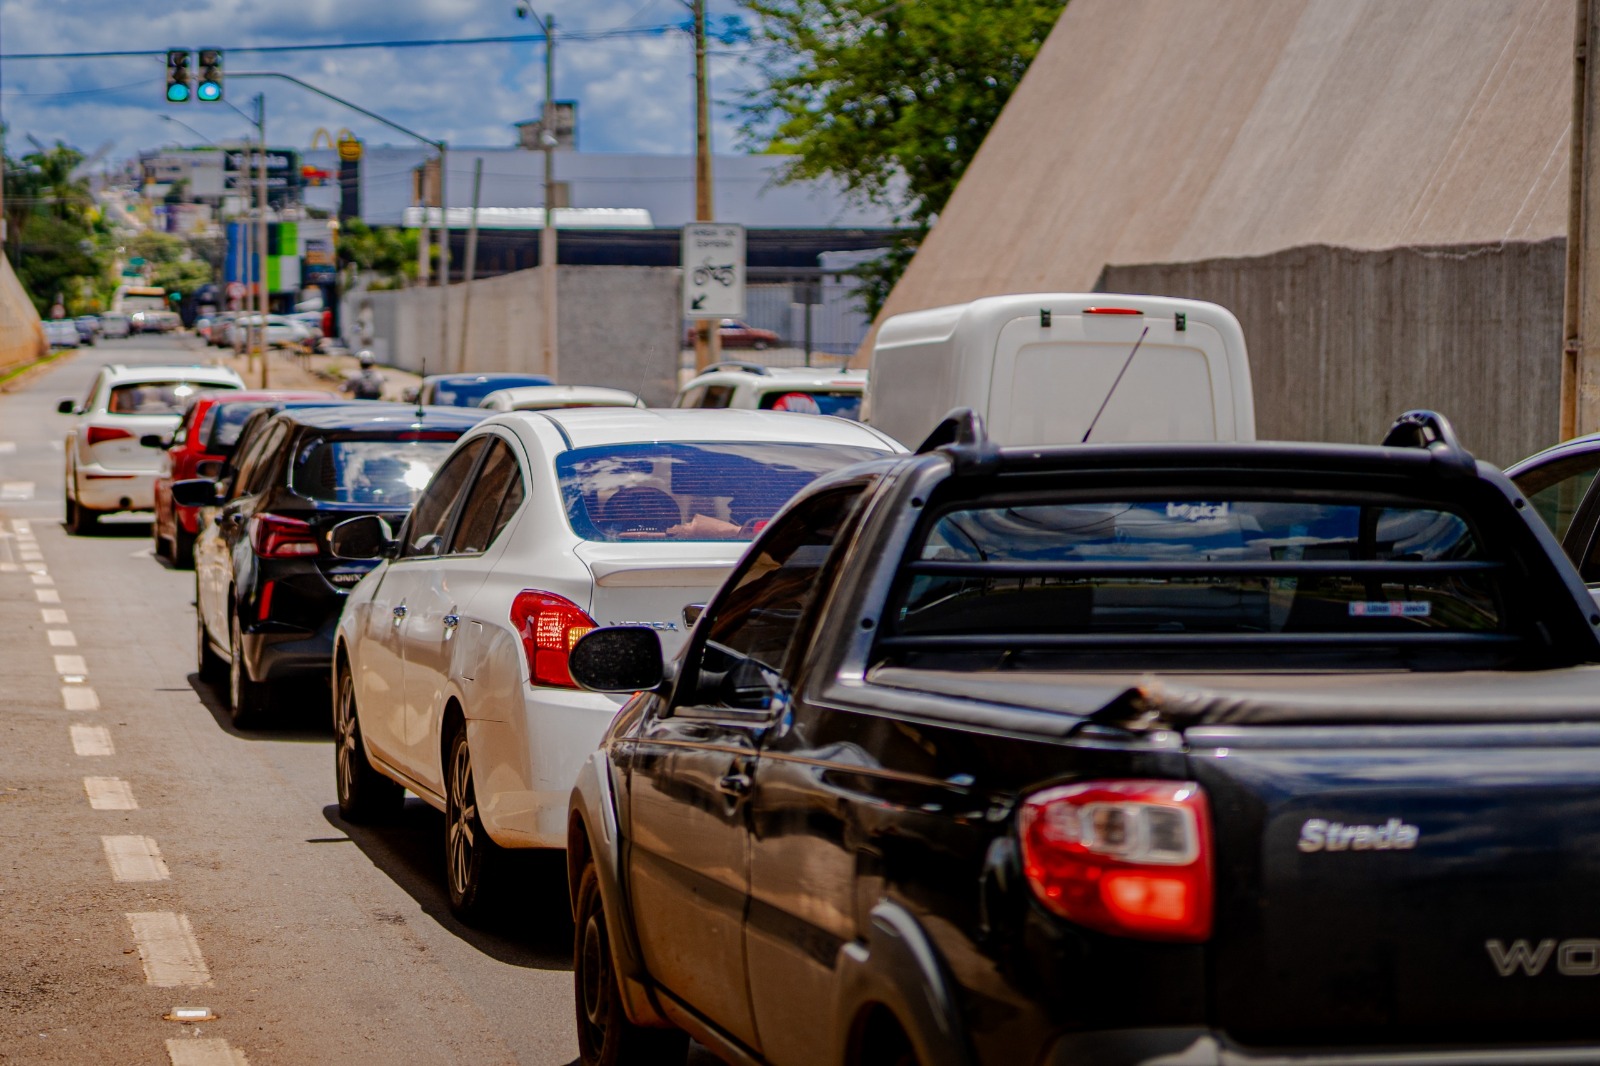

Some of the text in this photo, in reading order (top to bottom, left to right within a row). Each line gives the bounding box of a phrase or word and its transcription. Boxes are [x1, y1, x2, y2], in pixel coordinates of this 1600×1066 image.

[333, 574, 361, 582] ONIX
[1298, 818, 1420, 852] Strada
[1485, 939, 1600, 976] WO
